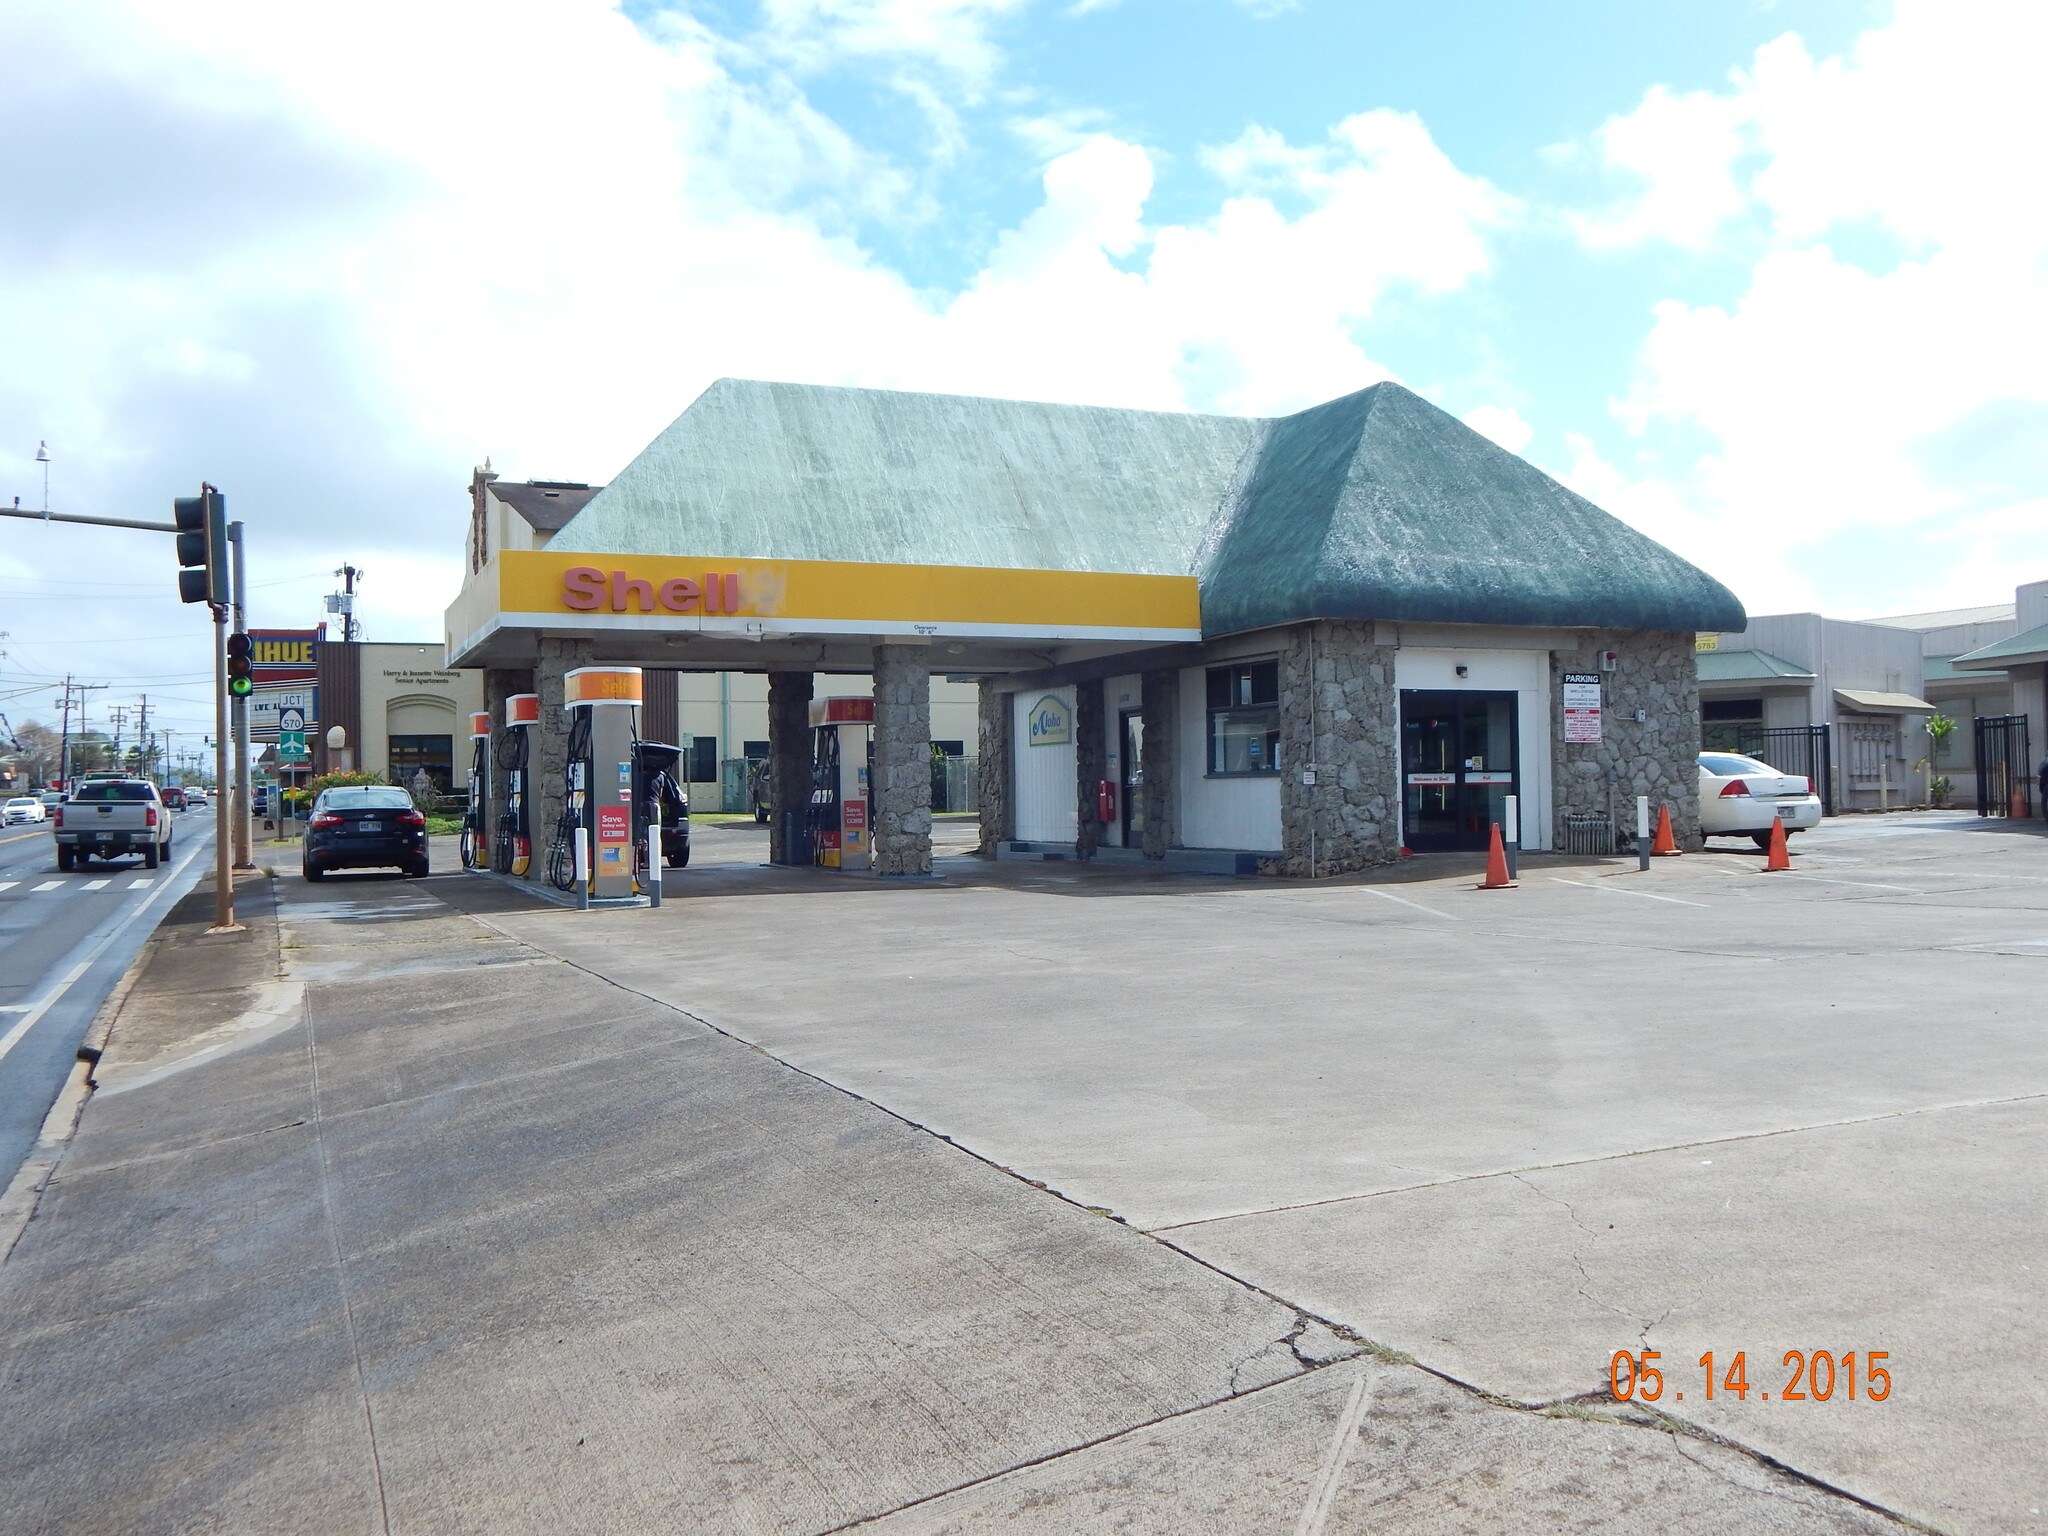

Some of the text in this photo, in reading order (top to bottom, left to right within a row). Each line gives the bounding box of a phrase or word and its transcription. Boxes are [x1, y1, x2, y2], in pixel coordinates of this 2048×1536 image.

[562, 566, 739, 612] Shell
[252, 641, 313, 662] IHUE
[1565, 674, 1599, 683] PARKING
[601, 677, 629, 694] Self
[283, 695, 302, 706] JCT
[847, 703, 867, 716] Self
[284, 719, 301, 728] 570
[1033, 710, 1061, 736] Aloha
[602, 815, 623, 823] Save
